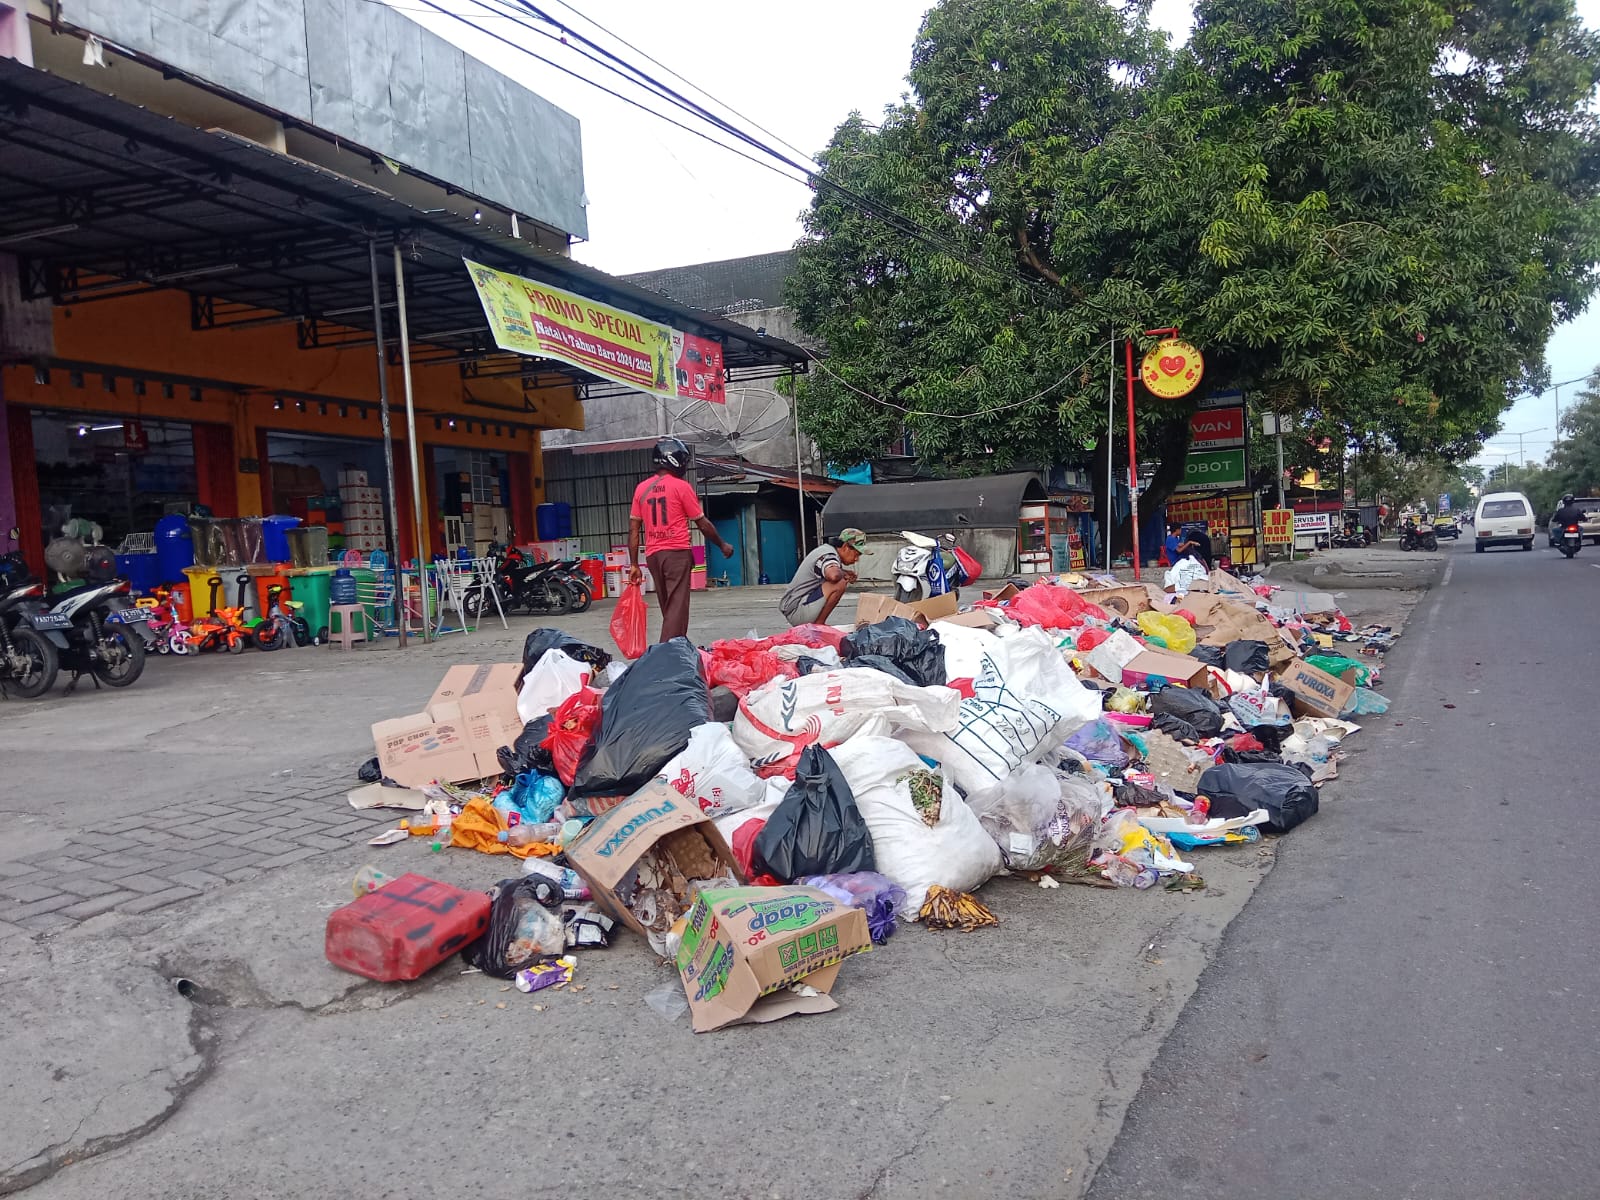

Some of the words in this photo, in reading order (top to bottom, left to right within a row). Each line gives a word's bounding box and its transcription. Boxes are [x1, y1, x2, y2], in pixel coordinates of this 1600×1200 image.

[522, 285, 584, 322] PROMO
[587, 308, 645, 344] SPECIAL
[533, 320, 561, 340] Natal
[568, 334, 597, 355] Tahun
[596, 344, 616, 360] Baru
[1186, 460, 1232, 474] OBOT
[647, 496, 668, 527] 11
[1271, 511, 1291, 525] HP
[1295, 674, 1336, 699] PUROXA
[387, 739, 405, 749] POP
[407, 730, 430, 742] CHOC
[596, 800, 679, 857] PUROXA
[748, 930, 766, 946] 20
